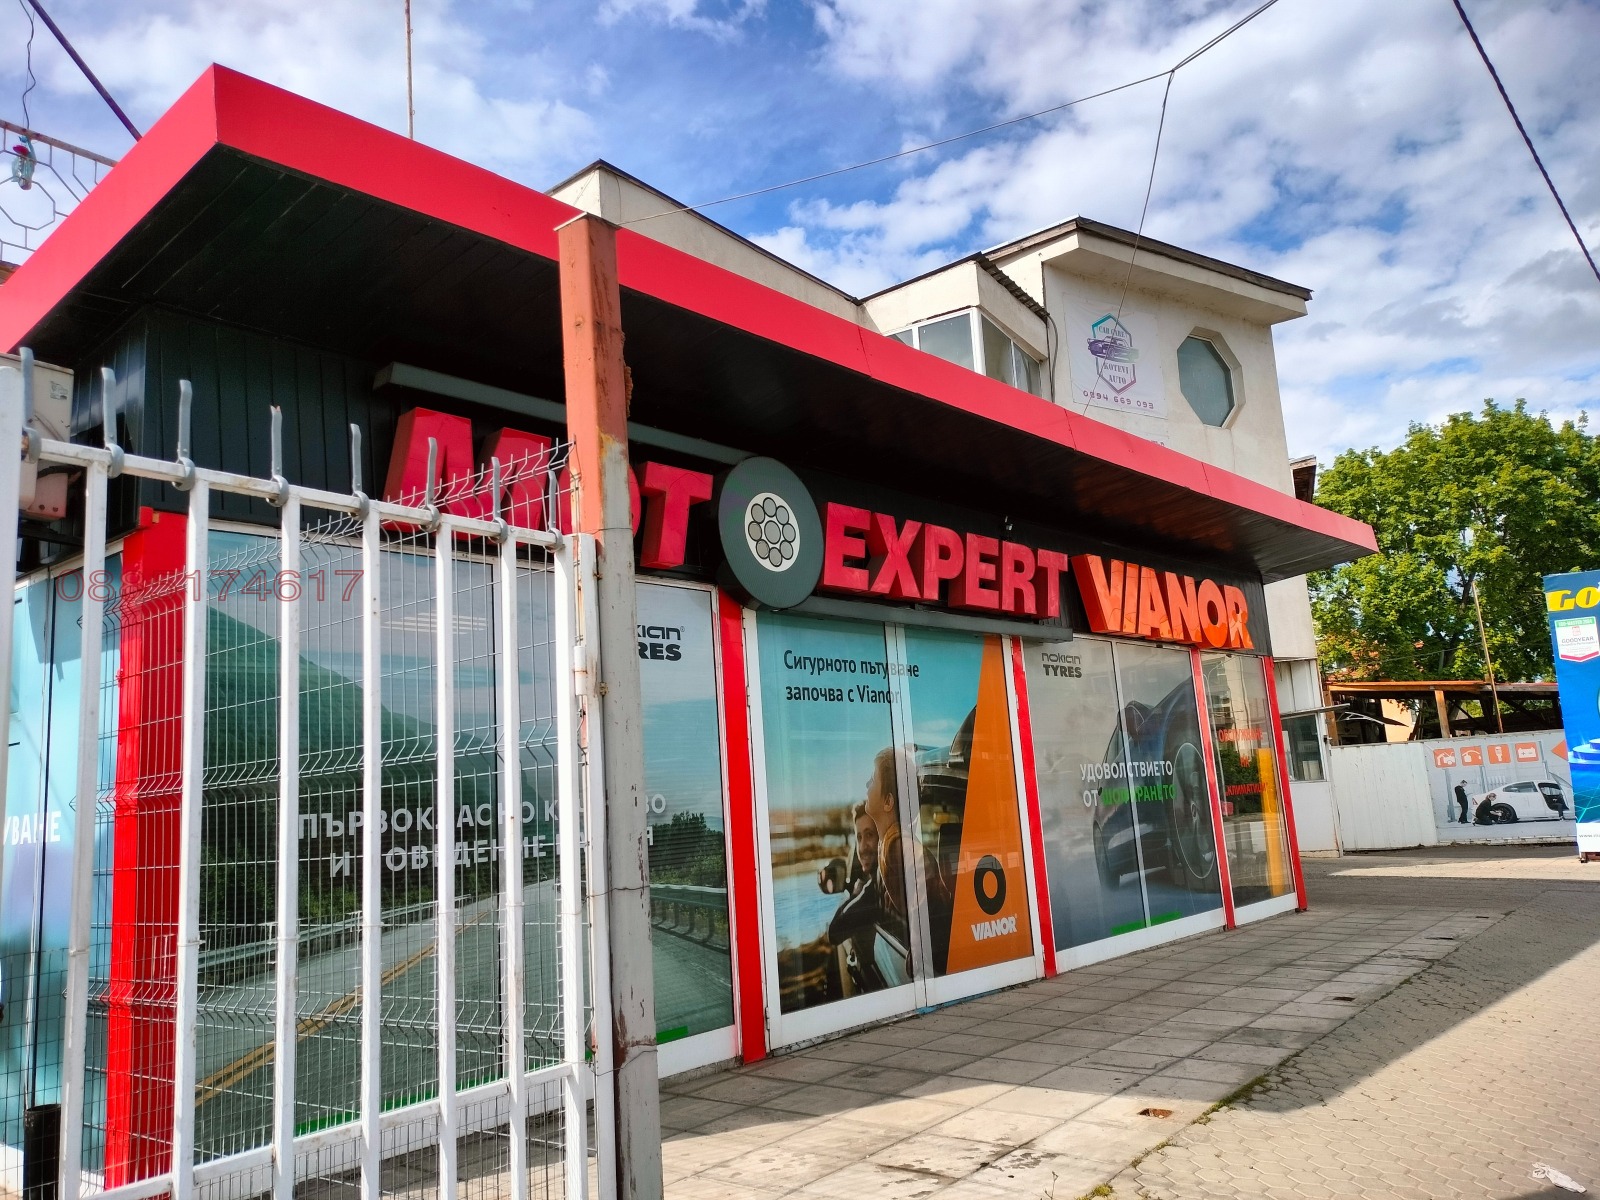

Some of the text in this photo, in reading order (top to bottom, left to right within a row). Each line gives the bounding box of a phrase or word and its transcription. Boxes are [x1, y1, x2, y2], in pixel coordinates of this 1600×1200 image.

[1109, 374, 1127, 384] AUTO
[1113, 395, 1132, 405] 669
[1136, 400, 1154, 409] 093
[822, 501, 1068, 618] EXPERT
[1072, 553, 1254, 649] VIANOR
[783, 649, 920, 679] Сигурното пътуване
[1043, 664, 1082, 678] TYRES
[785, 684, 900, 703] започва с Vianor
[1080, 760, 1173, 782] УДОВОЛСТВИЕТО
[1083, 789, 1099, 807] ОТ
[971, 916, 1017, 941] VIANOR
